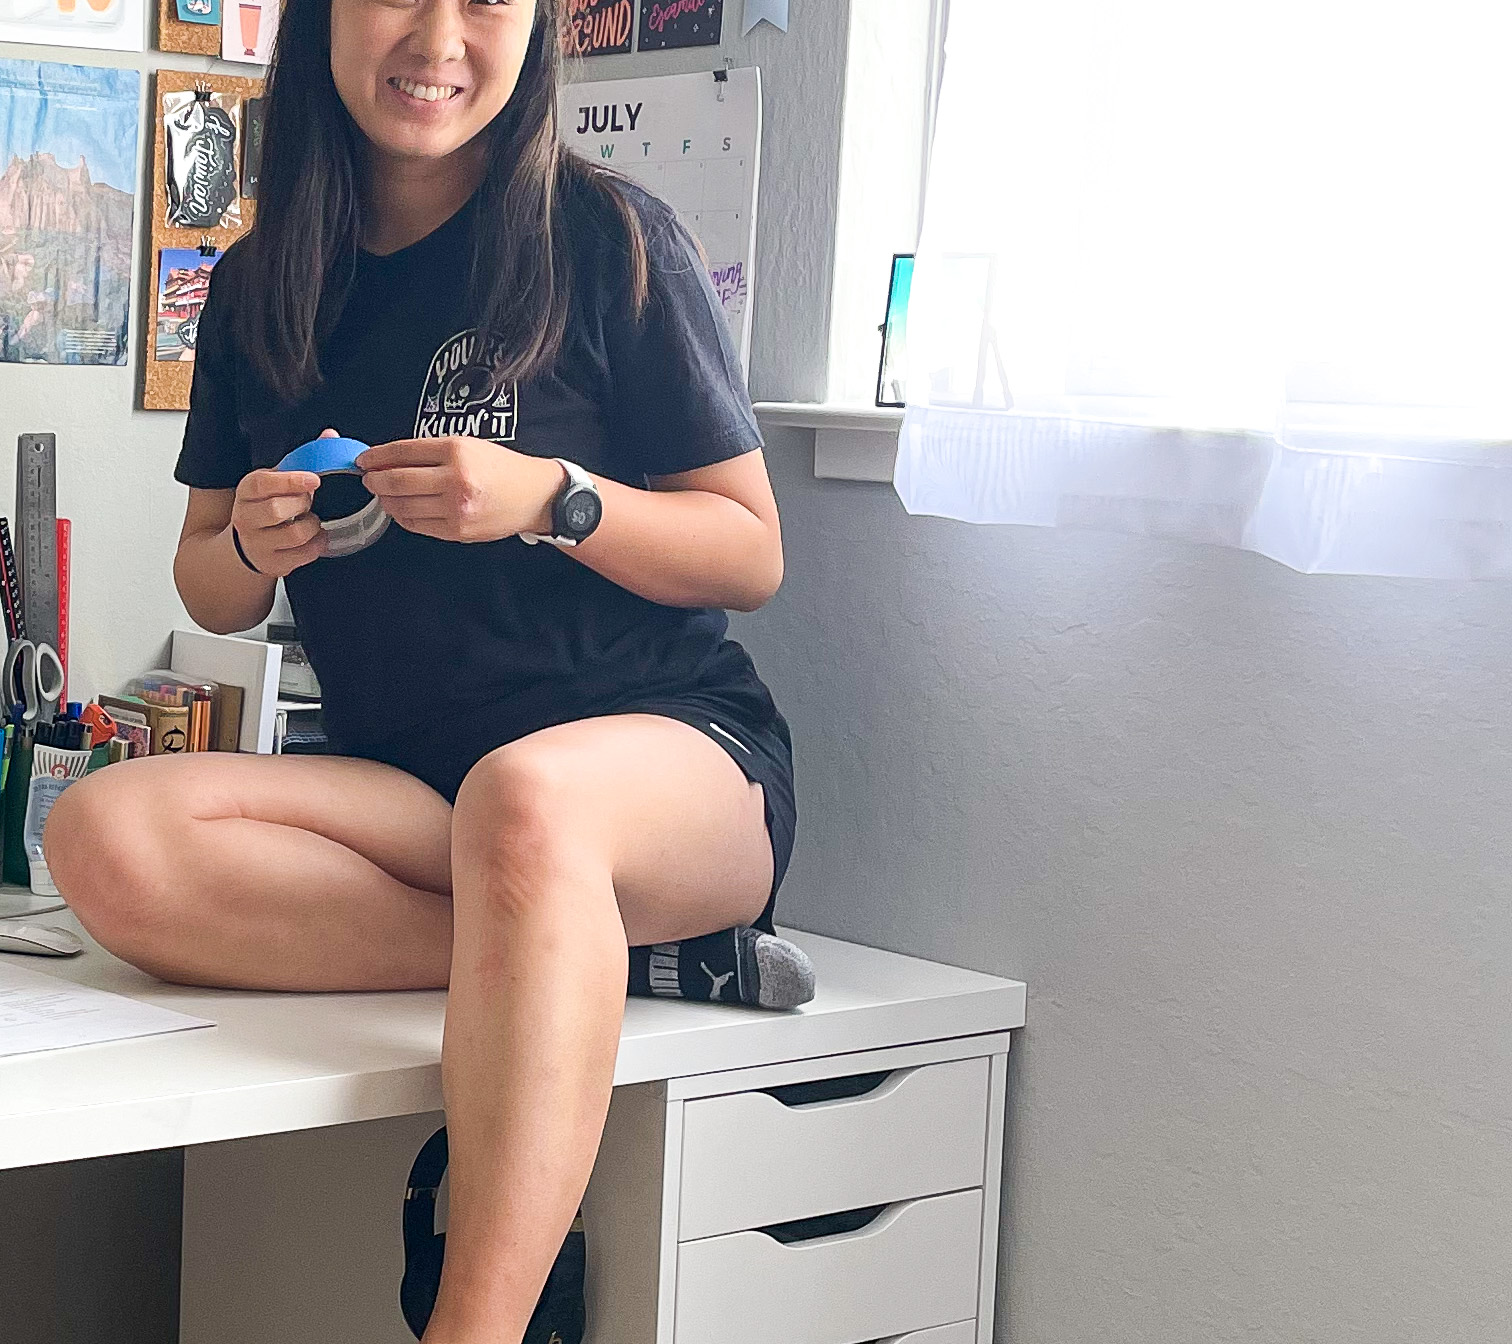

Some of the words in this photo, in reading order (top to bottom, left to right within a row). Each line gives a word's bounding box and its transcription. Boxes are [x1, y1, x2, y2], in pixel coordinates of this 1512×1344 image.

[576, 102, 643, 135] JULY
[600, 143, 615, 159] W
[642, 141, 652, 157] T
[682, 139, 692, 155] F
[722, 136, 732, 152] S
